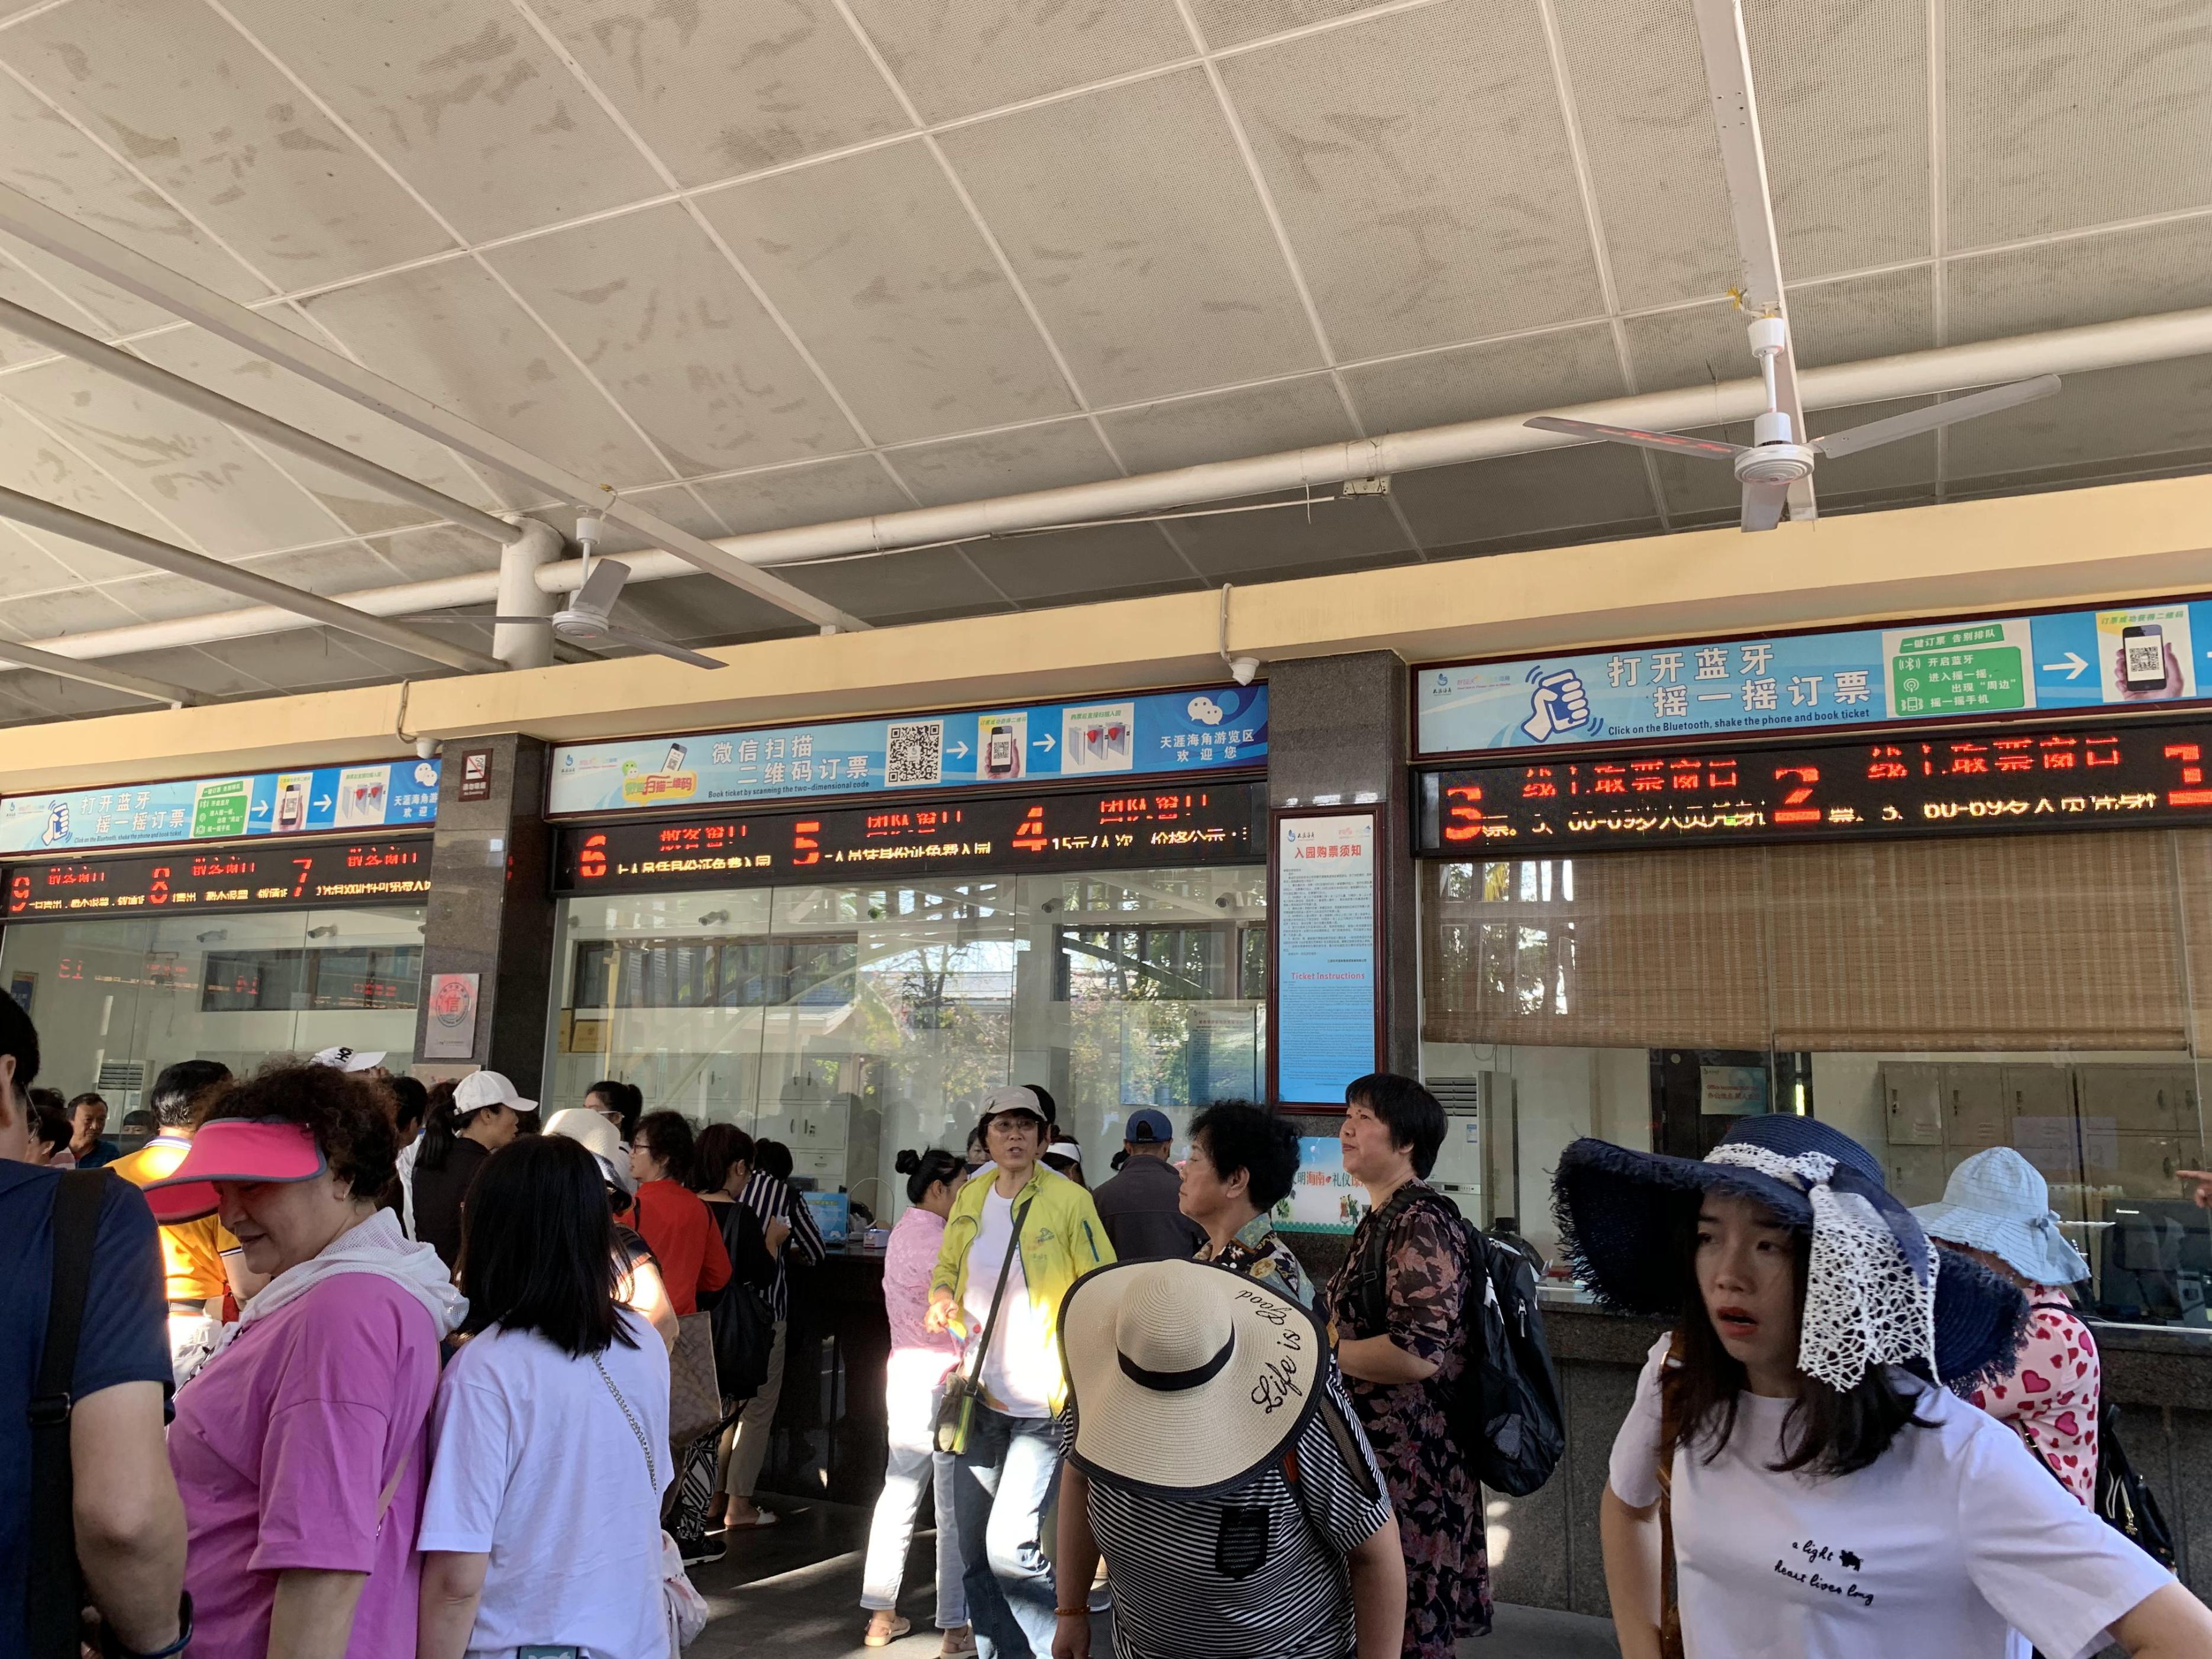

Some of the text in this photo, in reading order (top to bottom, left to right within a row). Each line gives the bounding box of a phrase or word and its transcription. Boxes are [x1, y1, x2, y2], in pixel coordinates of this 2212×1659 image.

[1903, 628, 1995, 648] 一键订票 告别排队
[1607, 643, 1775, 688] 打开蓝牙
[1927, 654, 1974, 667] 开启蓝牙
[1652, 670, 1872, 718] 摇一摇订票
[1930, 694, 1990, 708] 摇一摇手机
[1608, 725, 1630, 736] Click
[1646, 723, 1661, 733] the
[1663, 719, 1713, 732] Bluetooth,
[1714, 717, 1742, 728] shake
[1744, 716, 1761, 726] the
[1762, 714, 1793, 727] phone
[1794, 712, 1813, 722] and
[1814, 710, 1839, 721] book
[1841, 708, 1870, 719] ticket
[712, 734, 813, 764] 微信扫描
[1160, 729, 1254, 748] 天涯海角游览区
[1177, 746, 1237, 762] 欢迎您
[738, 755, 869, 785] 二维码订票
[81, 791, 151, 815] 打开蓝牙
[753, 786, 782, 796] scanning
[795, 782, 852, 792] two-dimensional
[1774, 767, 1821, 823] 2
[96, 808, 185, 834] 摇一摇订票
[403, 806, 437, 818] 欢迎
[1445, 786, 1481, 840] 3
[793, 821, 820, 865] 5
[1012, 806, 1047, 851] 4
[580, 834, 606, 876] 6
[1295, 844, 1362, 858] 入园购票须知
[150, 867, 170, 904] 8
[293, 858, 312, 897] 7
[12, 876, 30, 911] 9
[1293, 1171, 1325, 1186] 明海南
[1251, 1355, 1302, 1414] Life
[1277, 1329, 1301, 1350] is
[1803, 1540, 1833, 1563] light
[1775, 1560, 1874, 1606] heart lives long
